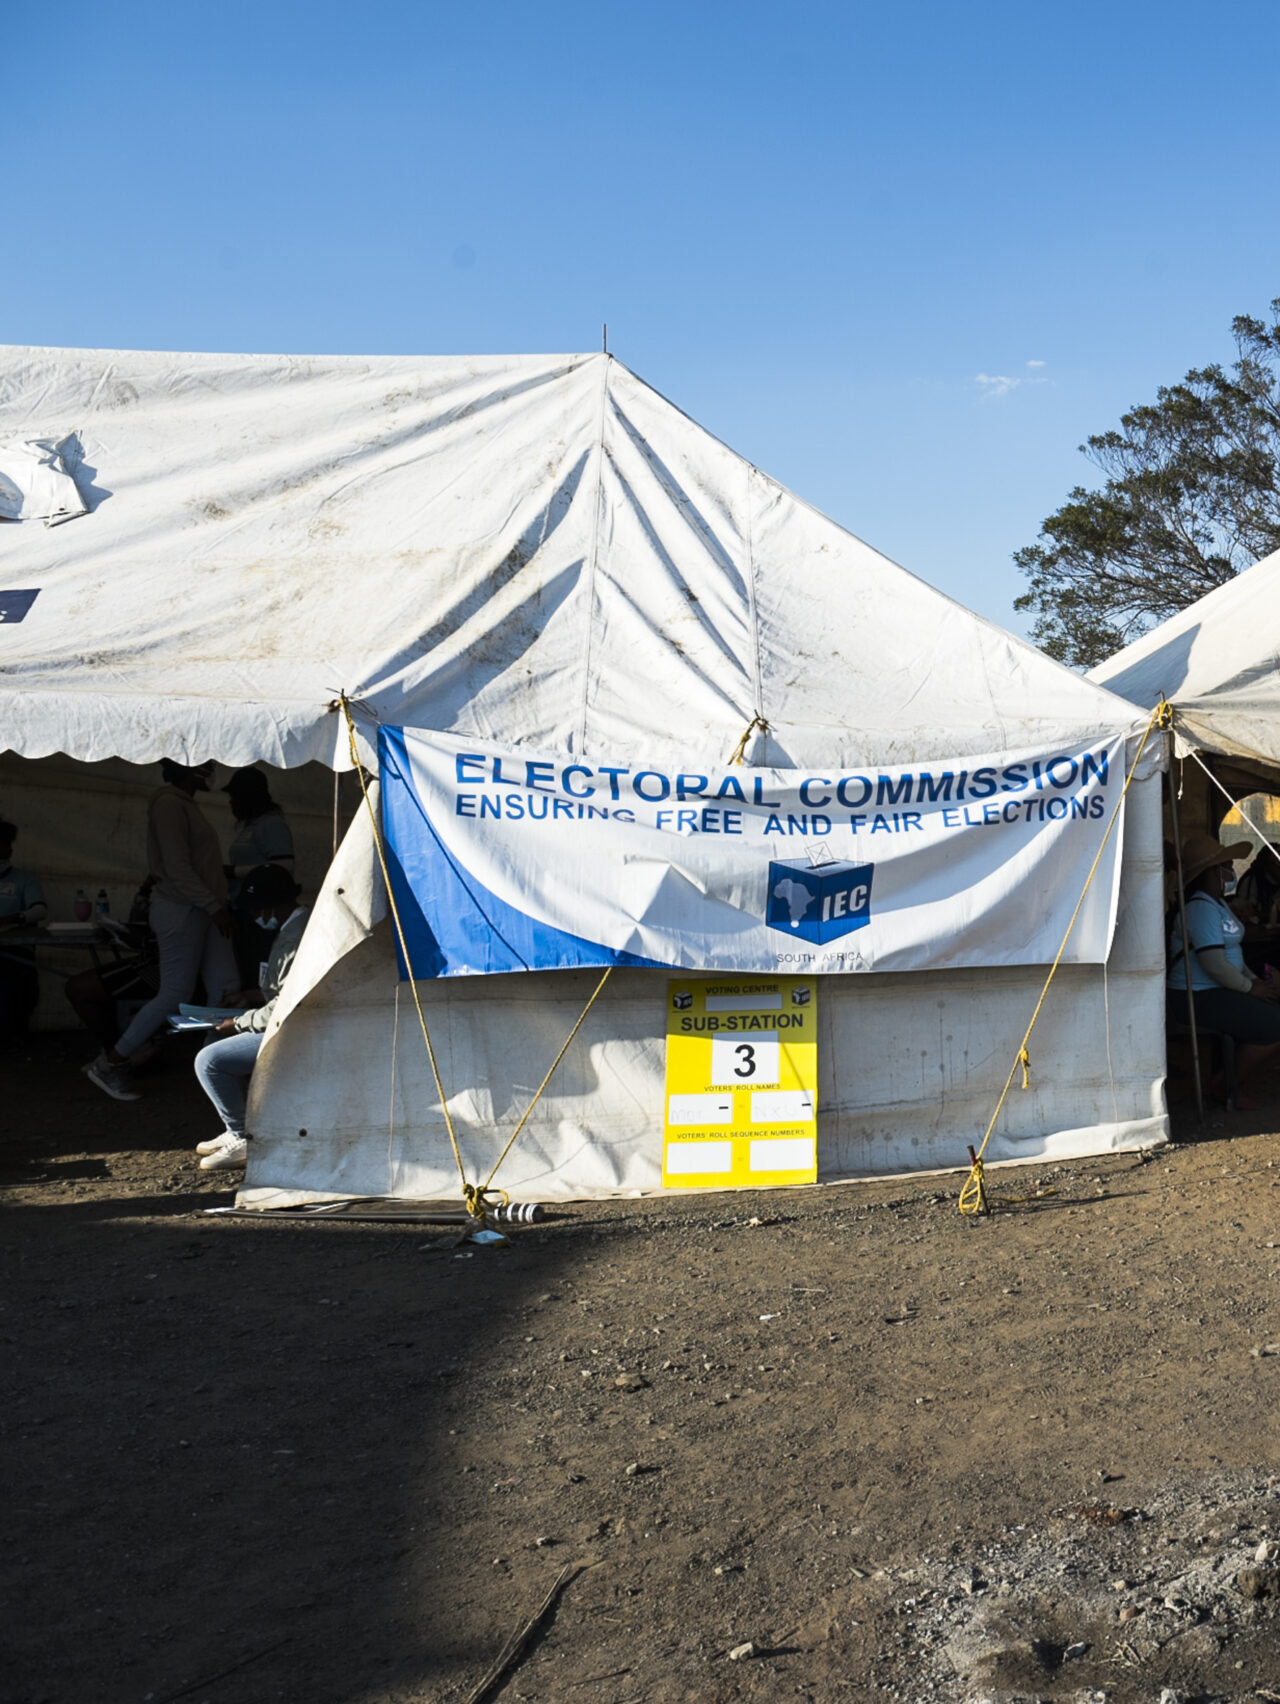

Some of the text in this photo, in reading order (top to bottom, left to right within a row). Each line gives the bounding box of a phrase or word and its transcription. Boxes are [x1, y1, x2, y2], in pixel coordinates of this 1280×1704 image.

[799, 750, 1110, 808] COMMISSION
[456, 793, 1106, 836] ENSURING FREE AND FAIR ELECTIONS
[822, 884, 868, 923] IEC
[776, 952, 864, 962] SOUTH AFRICA
[705, 984, 779, 994] VOTING CENTRE
[681, 1013, 803, 1031] SUB-STATION
[734, 1044, 756, 1078] 3
[730, 1130, 768, 1138] SEQUENCE
